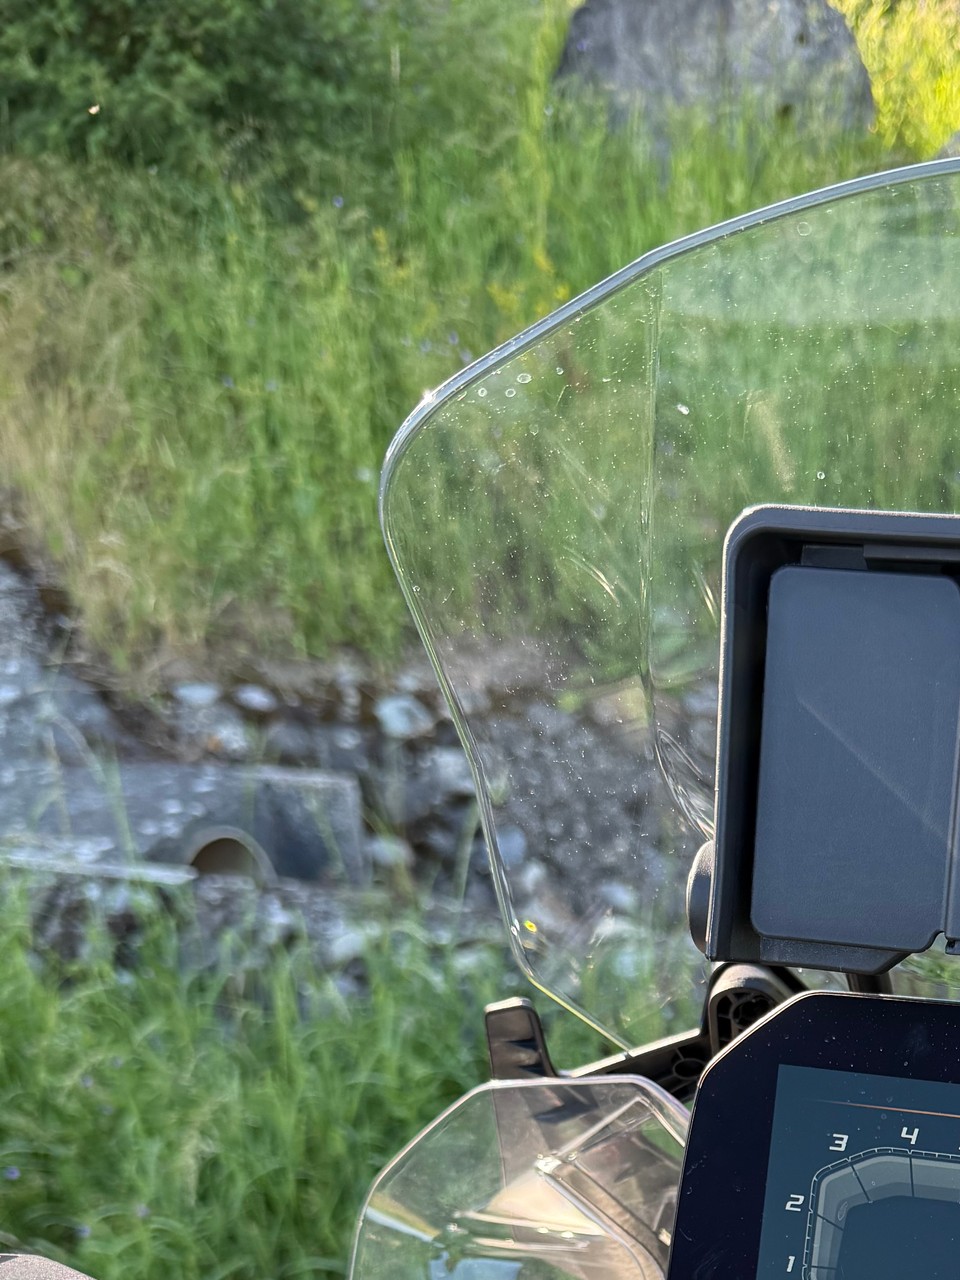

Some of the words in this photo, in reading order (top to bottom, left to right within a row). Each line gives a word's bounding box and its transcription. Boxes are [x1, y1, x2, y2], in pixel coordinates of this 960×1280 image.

[829, 1133, 849, 1152] 3
[901, 1127, 919, 1145] 4
[785, 1194, 805, 1211] 2
[786, 1255, 795, 1272] 1
